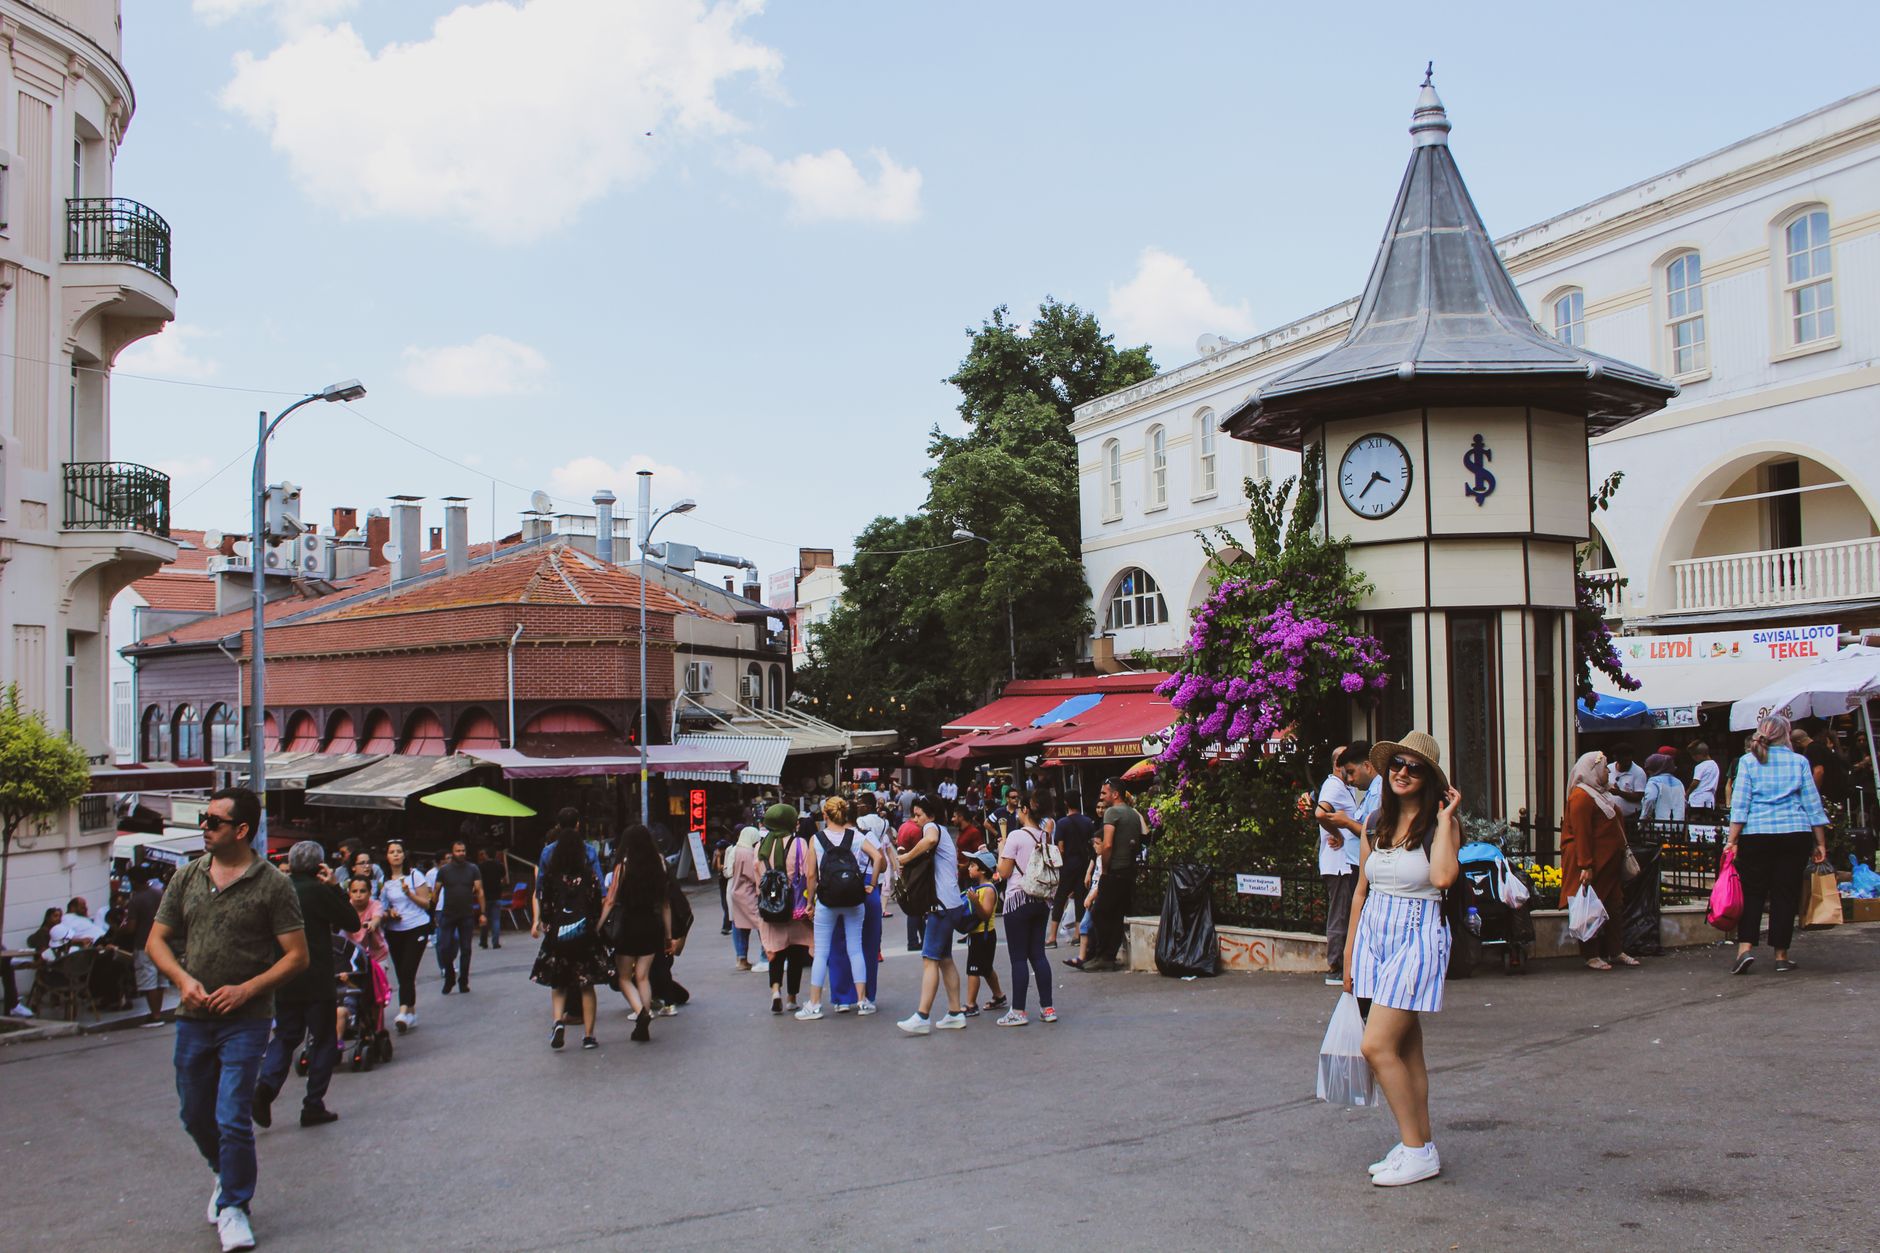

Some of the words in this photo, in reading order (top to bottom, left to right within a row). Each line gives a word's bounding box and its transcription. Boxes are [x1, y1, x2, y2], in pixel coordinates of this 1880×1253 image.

[1368, 438, 1382, 449] XII
[1345, 473, 1353, 486] IX
[1372, 503, 1384, 513] VI
[1753, 630, 1800, 643] SAYISAL
[1802, 626, 1834, 640] LOTO
[1650, 637, 1692, 658] LEYDİ
[1768, 641, 1818, 659] TEKEL
